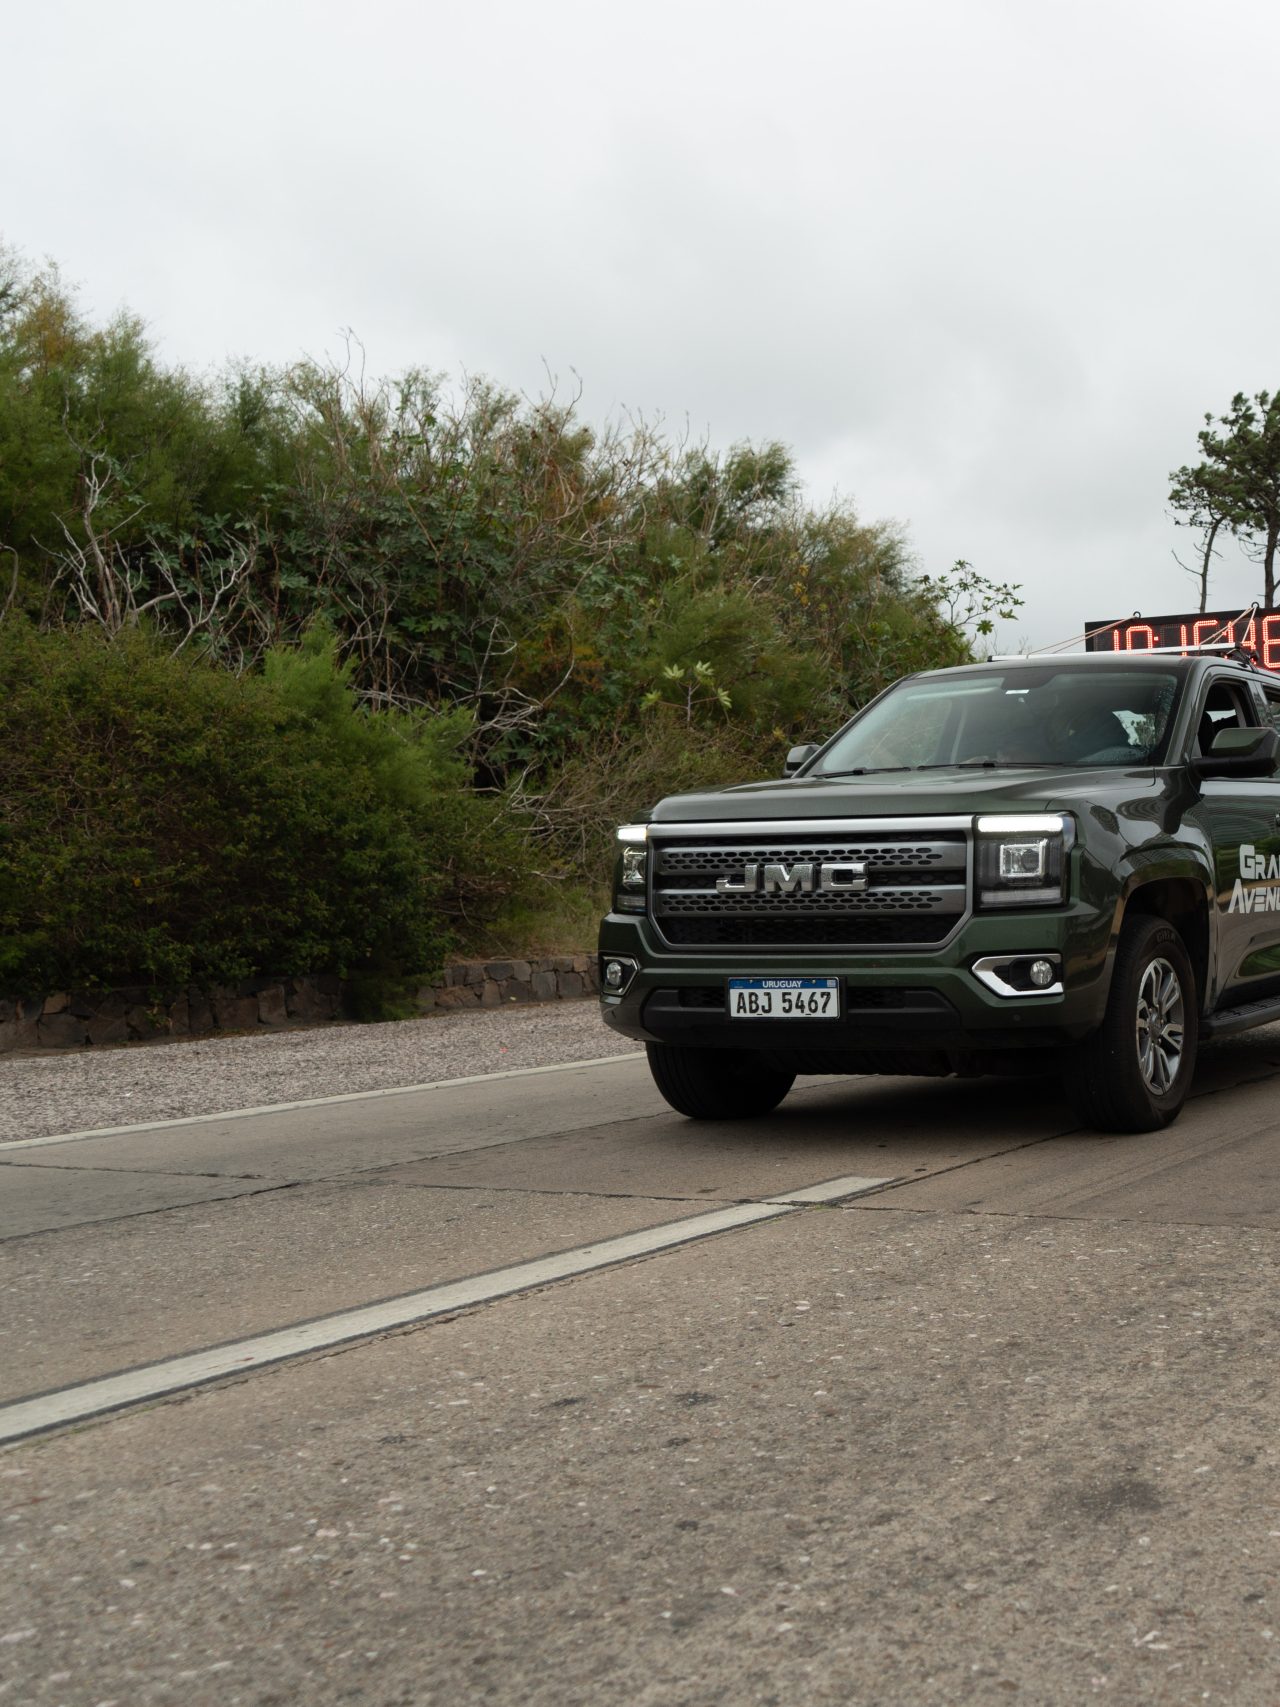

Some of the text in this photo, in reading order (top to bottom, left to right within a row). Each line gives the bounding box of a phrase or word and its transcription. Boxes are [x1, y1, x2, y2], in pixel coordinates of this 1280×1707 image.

[716, 862, 869, 893] JMC
[762, 980, 802, 988] URUGUAY
[736, 991, 831, 1014] ABJ 5467
